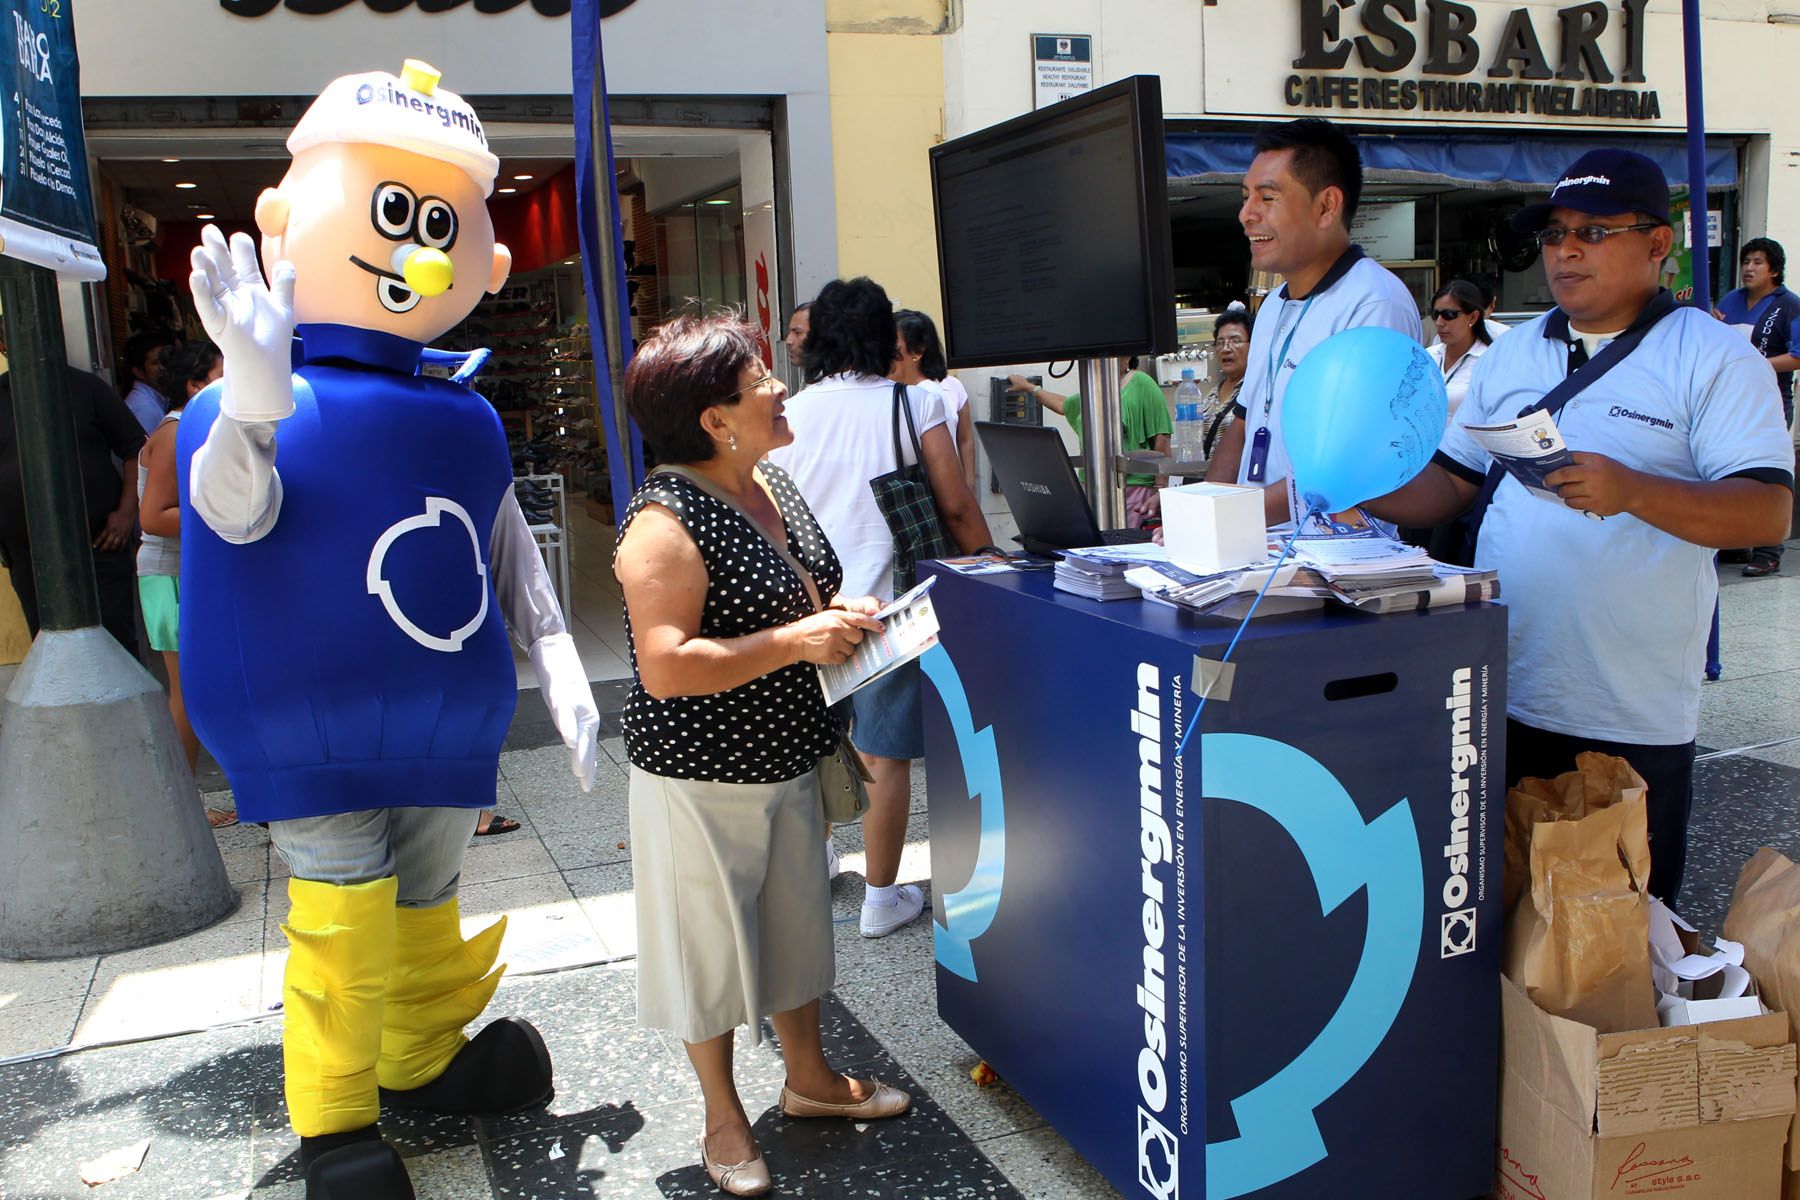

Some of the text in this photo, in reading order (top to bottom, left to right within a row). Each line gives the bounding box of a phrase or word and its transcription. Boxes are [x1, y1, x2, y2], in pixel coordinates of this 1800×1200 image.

[1292, 0, 1646, 83] ESBARI
[356, 82, 484, 145] Osinergmin
[1285, 75, 1359, 109] CAFE
[1362, 79, 1532, 114] RESTAURANT
[1762, 308, 1781, 335] IZOD
[1621, 408, 1674, 430] Osinergmin
[1020, 481, 1052, 495] TOSHIBA
[1443, 667, 1478, 909] Osinergmin
[1478, 664, 1489, 901] ORGANISMO SUPERVISOR DE LA INVERSIÓN EN ENERGÍA Y MINERÍA
[1131, 662, 1173, 1113] Osinergmin
[1171, 675, 1189, 1136] ORGANISMO SUPERVISOR DE LA INVERSIÓN EN ENERGÍA Y MINERÍA
[1652, 1176, 1675, 1186] style
